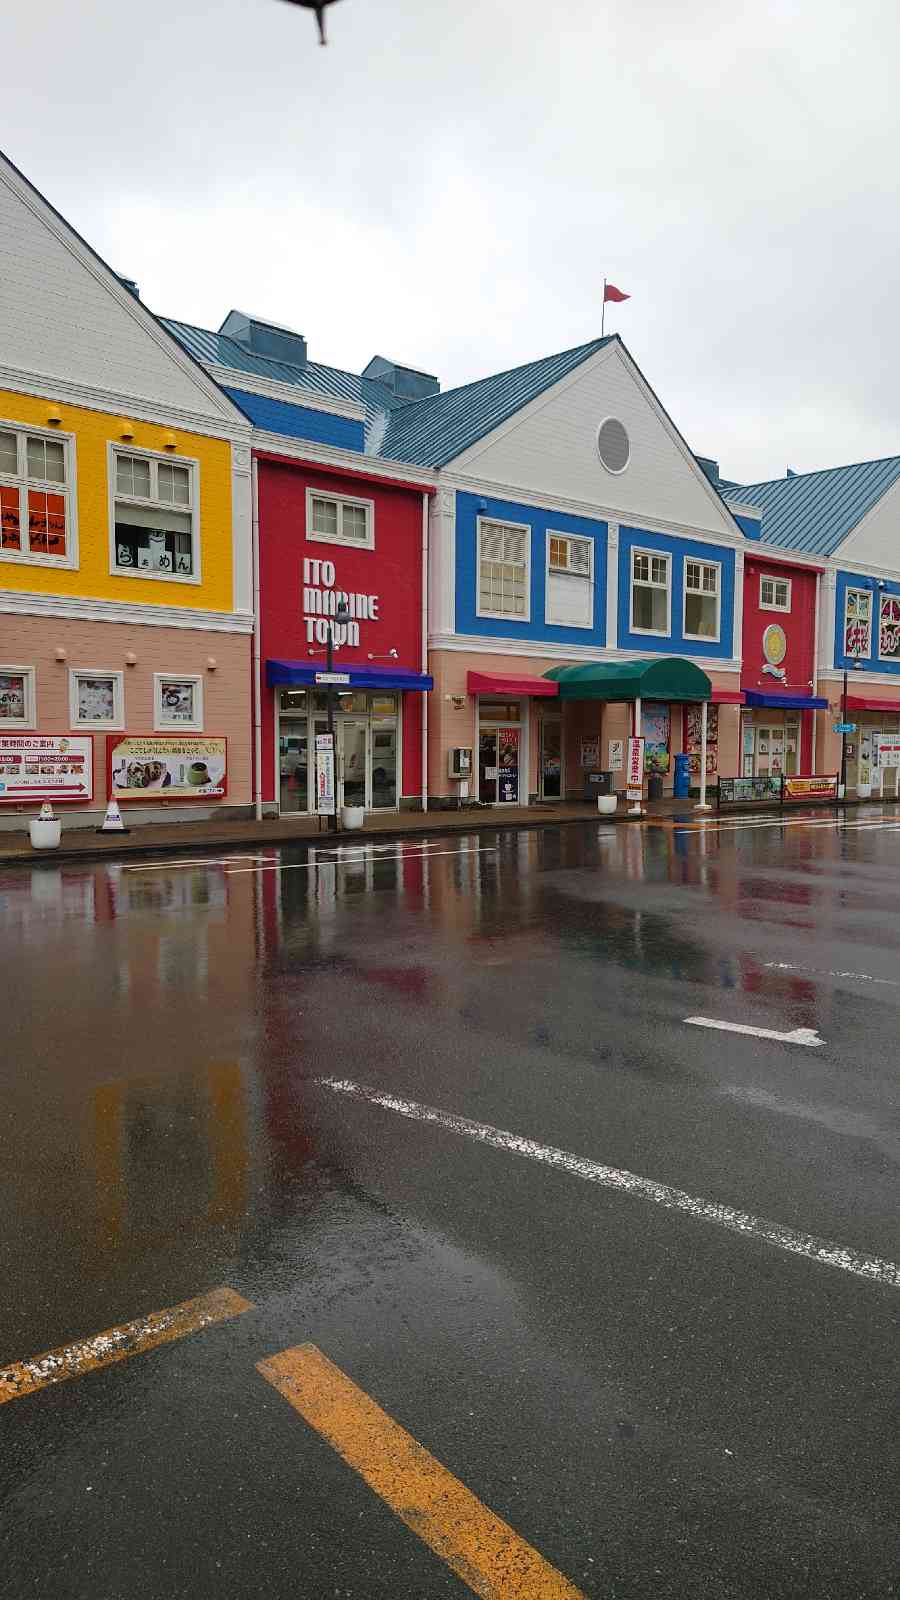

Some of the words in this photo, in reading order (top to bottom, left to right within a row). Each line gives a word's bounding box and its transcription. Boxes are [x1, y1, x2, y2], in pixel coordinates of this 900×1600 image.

[304, 558, 336, 587] ITO
[304, 588, 379, 620] MARINE
[304, 617, 360, 647] TOWN
[0, 739, 54, 748] 業時間のご案内
